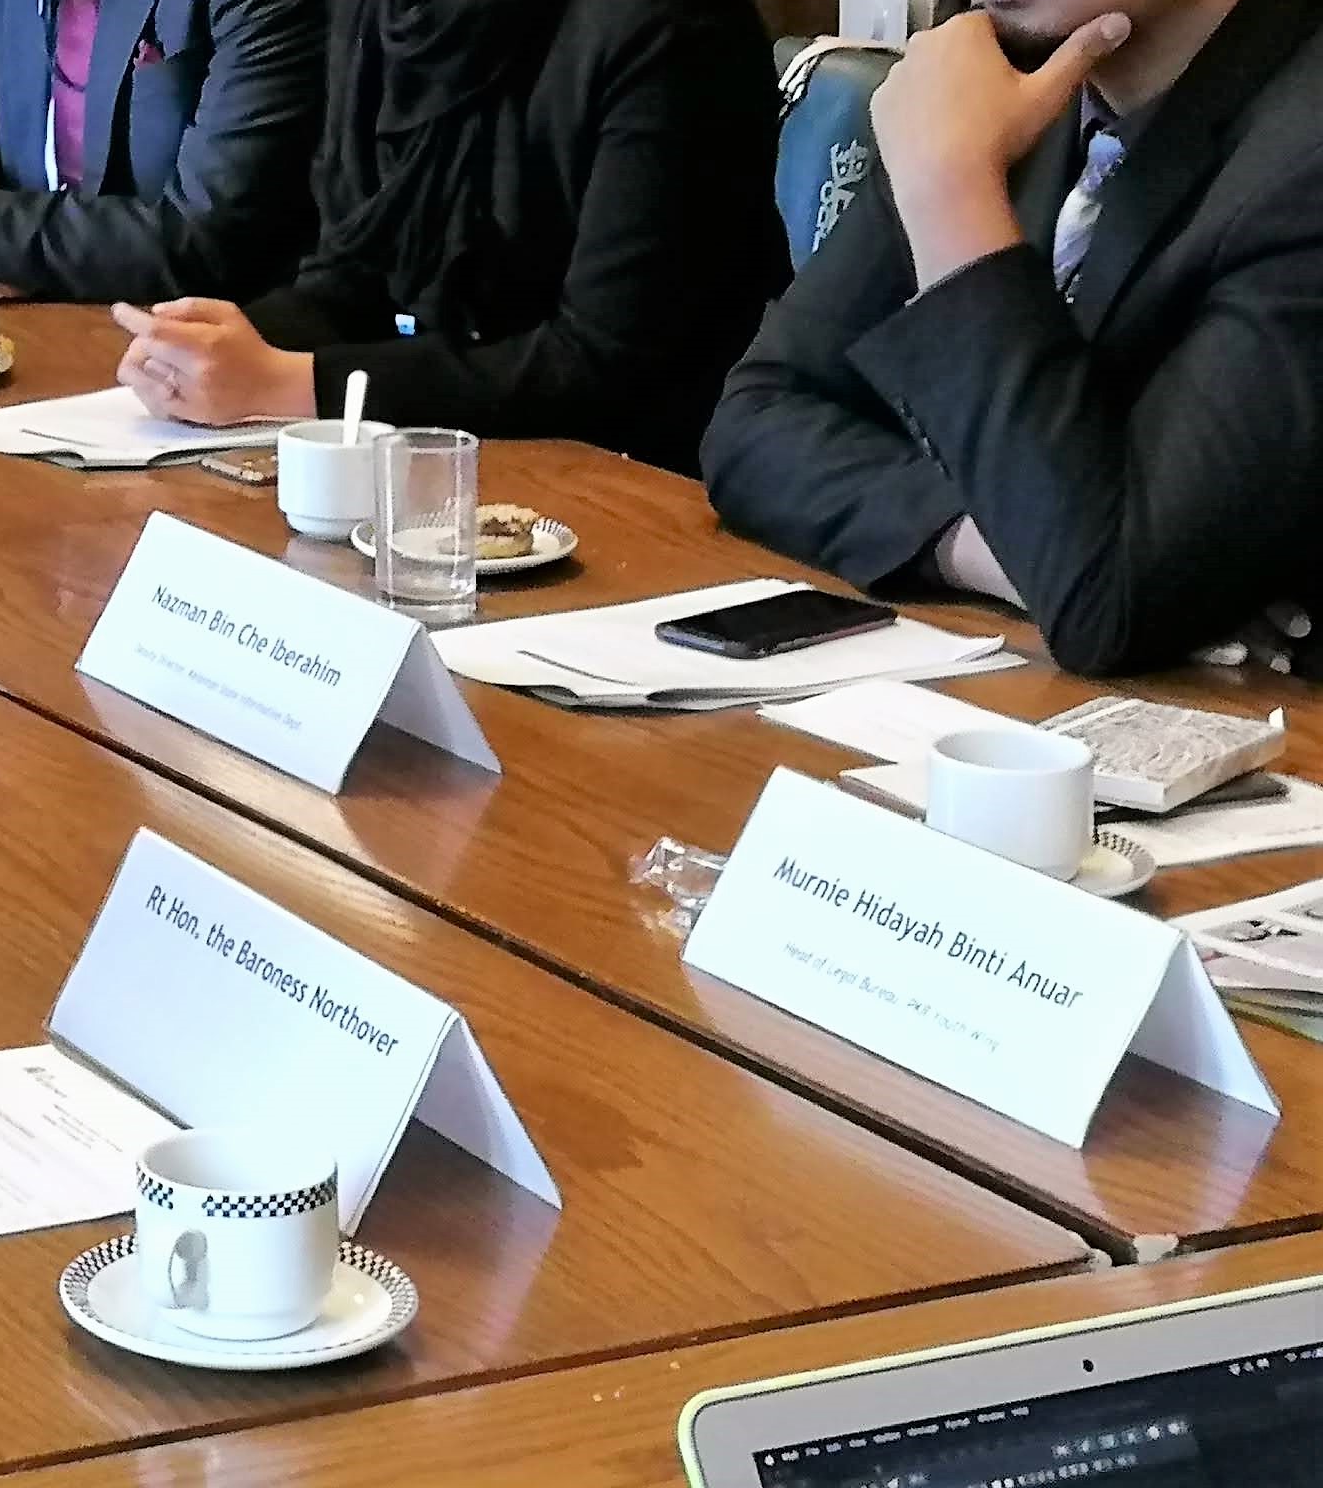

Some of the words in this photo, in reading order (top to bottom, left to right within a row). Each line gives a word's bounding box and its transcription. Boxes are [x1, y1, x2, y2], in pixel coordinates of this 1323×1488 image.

[151, 583, 208, 625] Nazman
[208, 609, 236, 639] Bin
[237, 623, 269, 654] Che
[269, 636, 341, 688] Iberahim
[145, 885, 167, 916] Rt
[206, 922, 236, 958] the
[234, 939, 309, 1003] Baroness
[308, 985, 400, 1057] Northover
[772, 856, 850, 908] Murnie
[852, 888, 944, 950] Hidayah
[947, 931, 1008, 976] Binti
[1006, 960, 1084, 1009] Anuar
